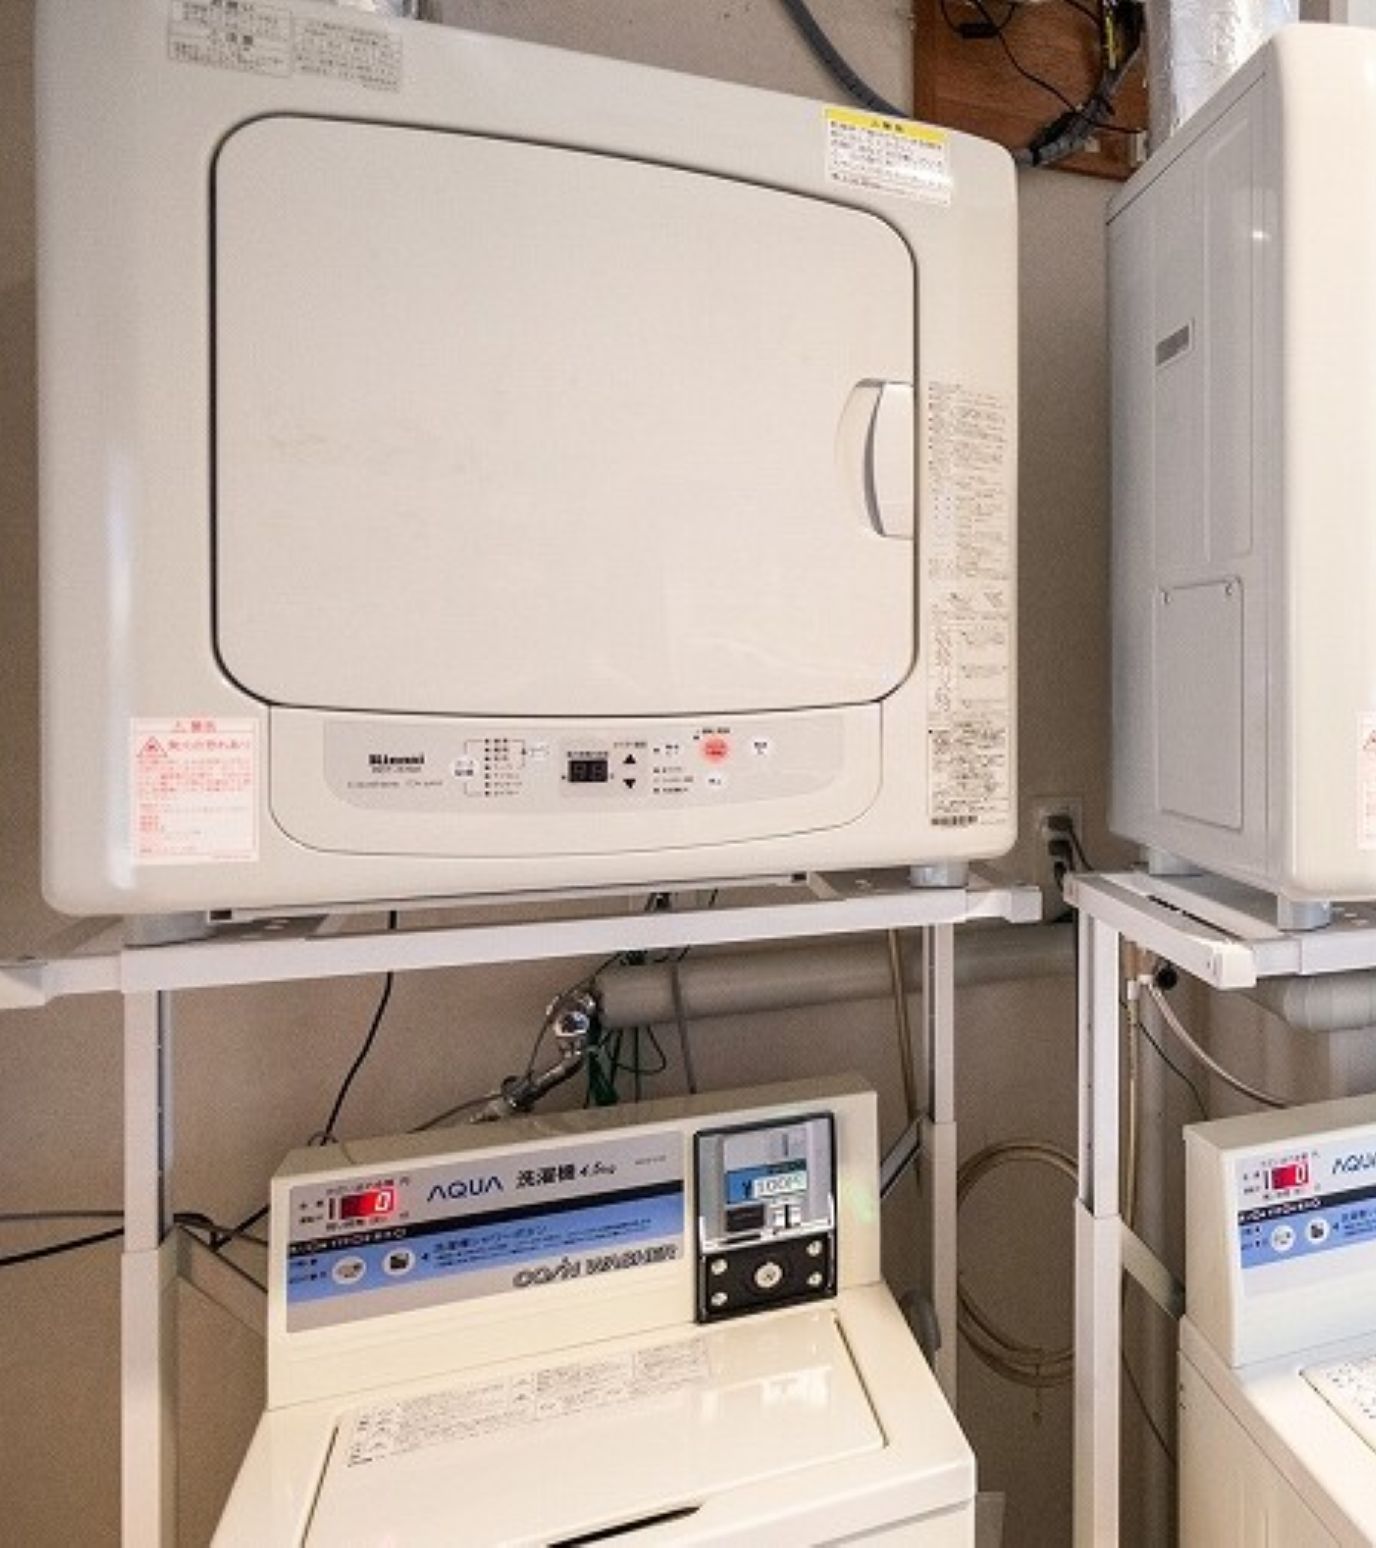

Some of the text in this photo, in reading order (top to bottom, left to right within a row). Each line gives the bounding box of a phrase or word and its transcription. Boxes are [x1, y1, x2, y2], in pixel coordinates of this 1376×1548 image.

[426, 1175, 504, 1203] AQUA
[516, 1163, 576, 1190] 洗濯機
[373, 1190, 392, 1212] 0
